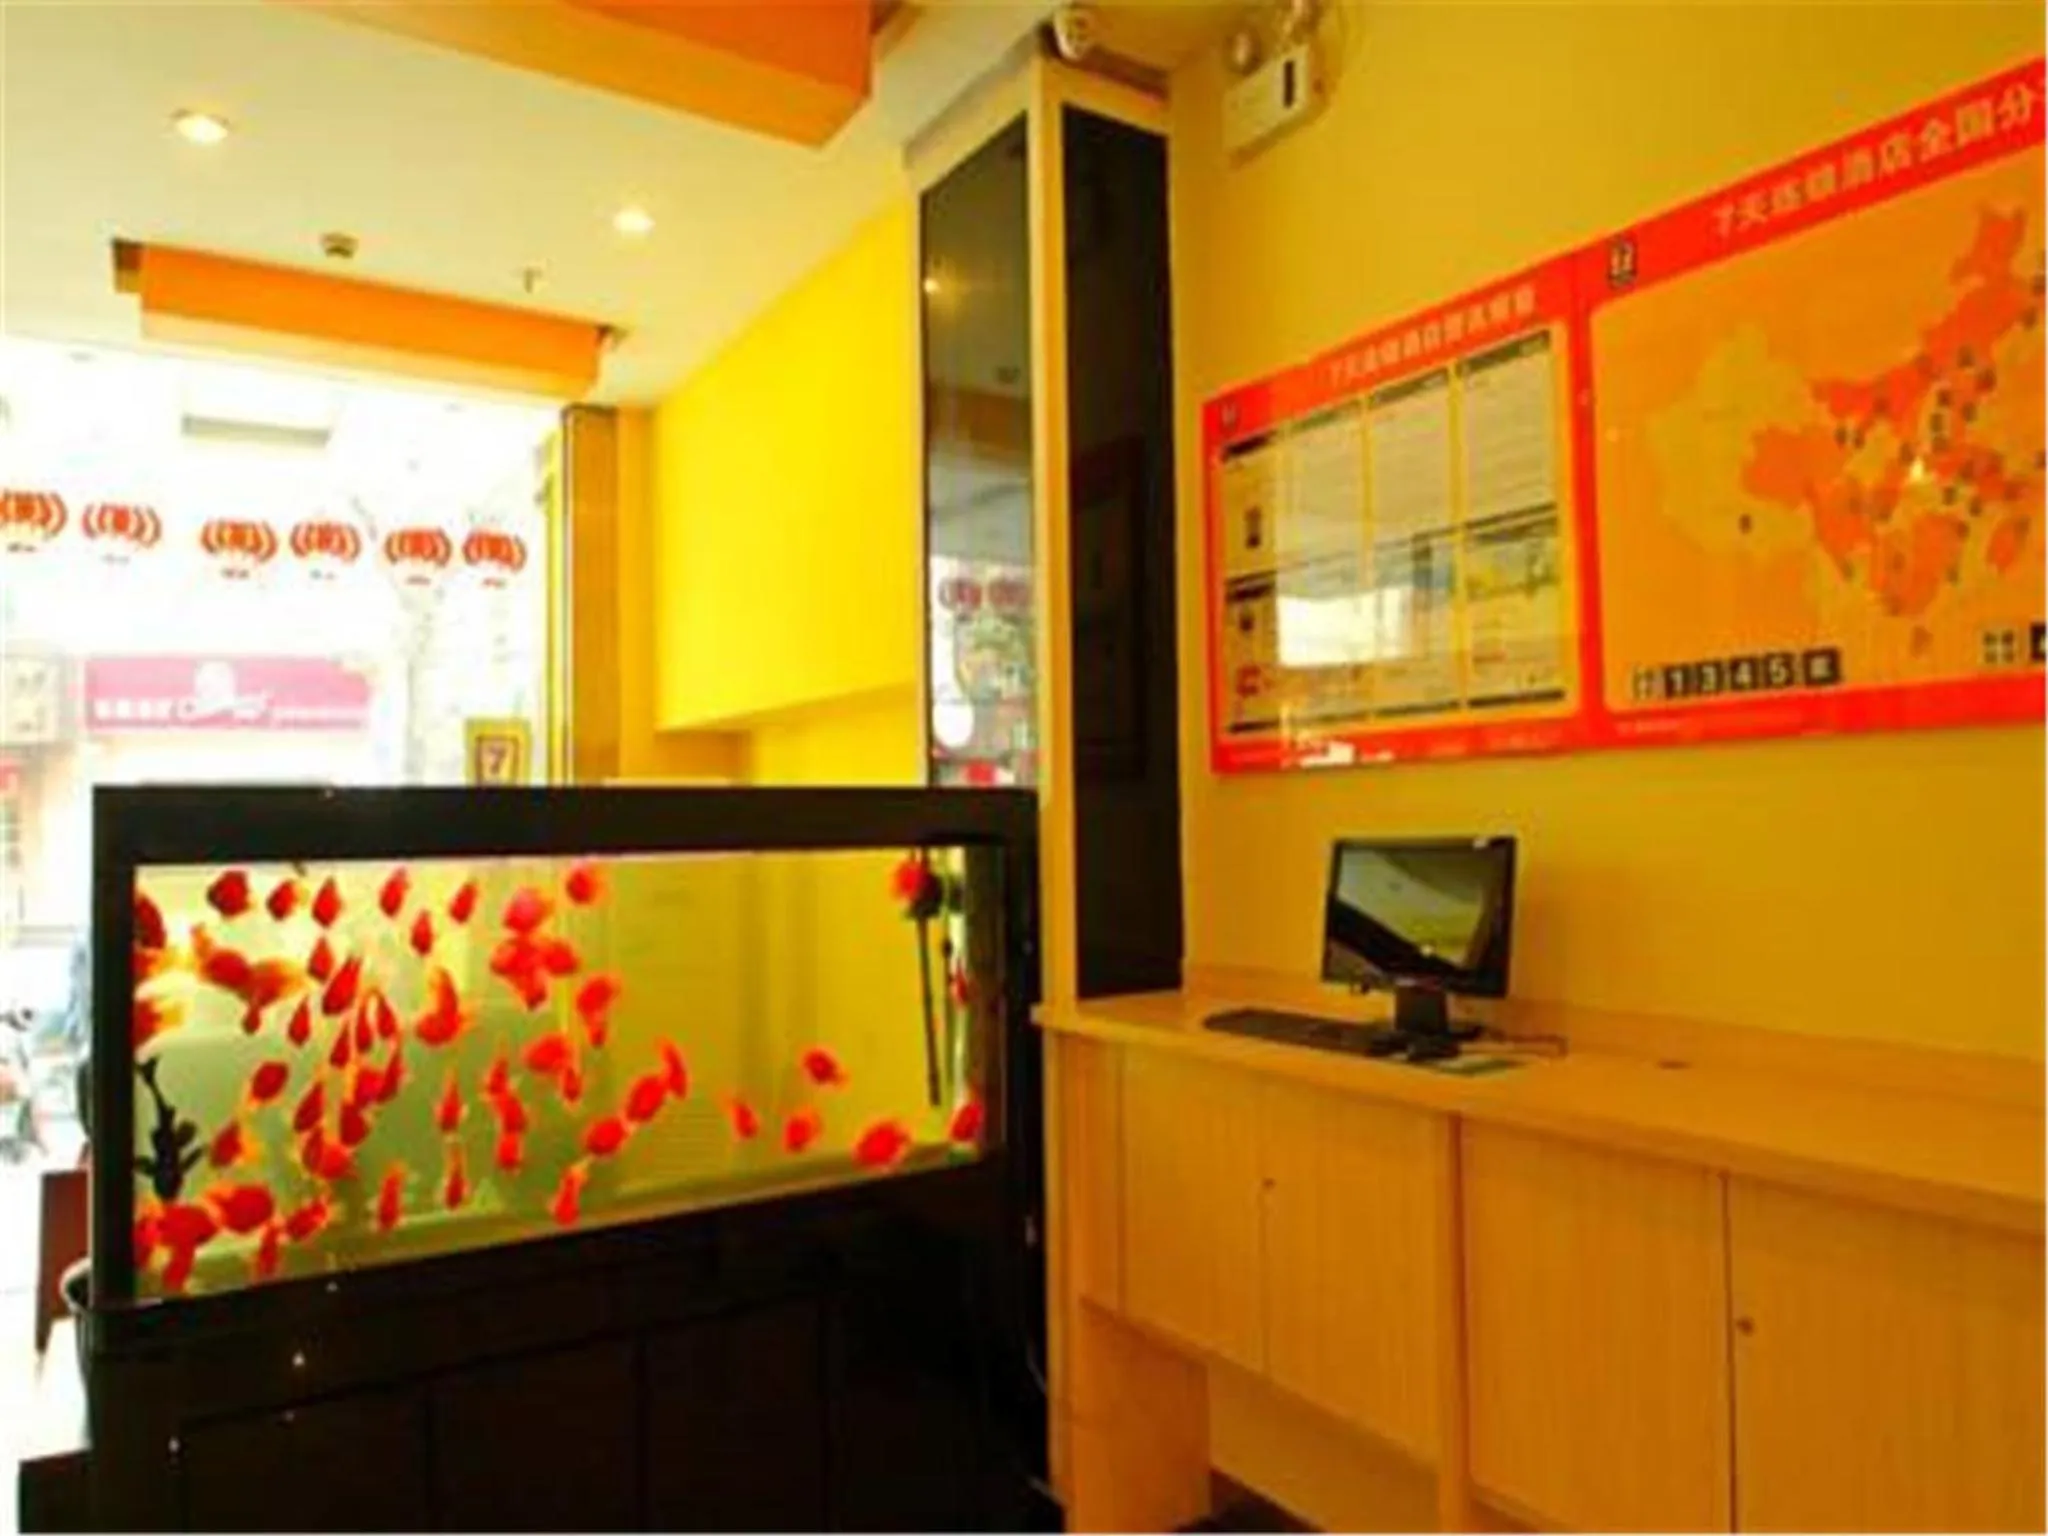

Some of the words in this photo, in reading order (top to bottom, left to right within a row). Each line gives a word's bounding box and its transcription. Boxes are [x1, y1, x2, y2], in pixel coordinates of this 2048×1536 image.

[1712, 80, 2045, 238] 7天连锁酒店全国分
